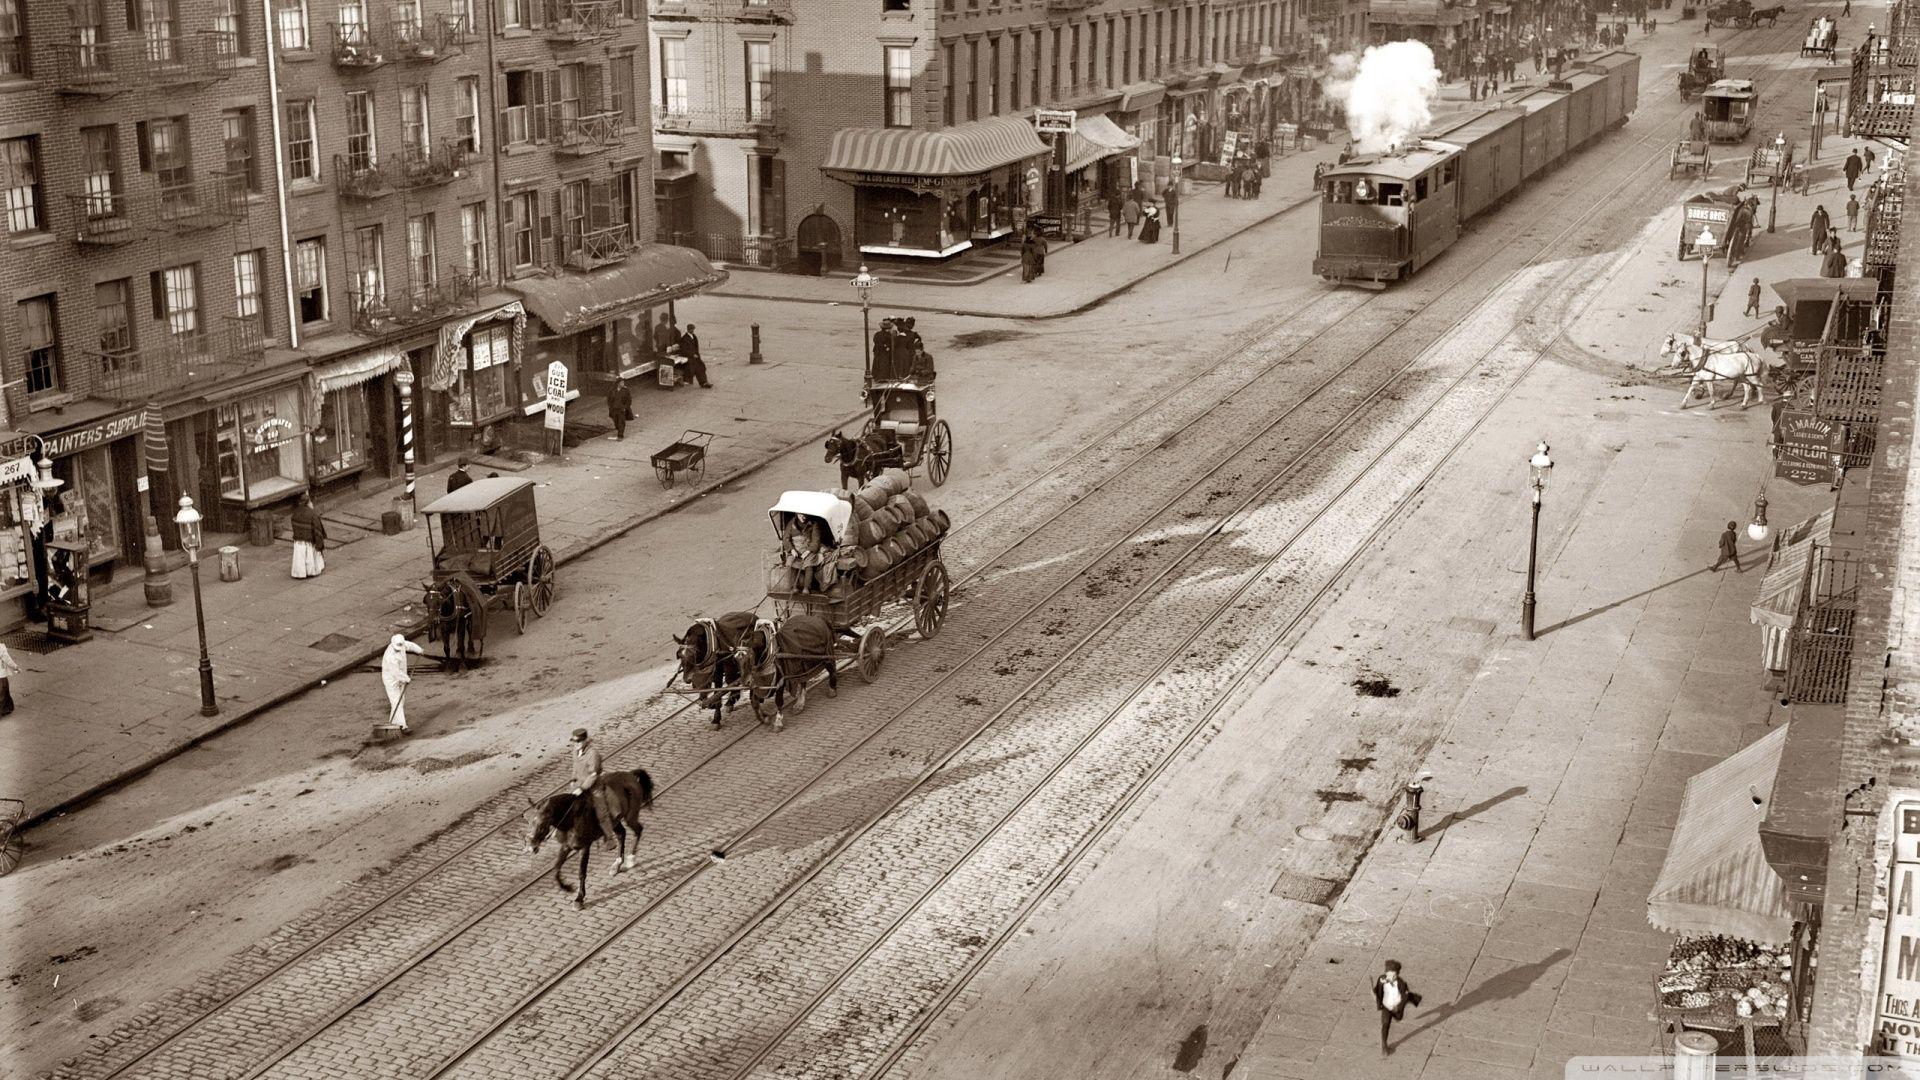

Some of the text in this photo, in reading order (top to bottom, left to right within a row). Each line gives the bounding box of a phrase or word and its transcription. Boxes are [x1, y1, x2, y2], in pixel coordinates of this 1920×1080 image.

[549, 377, 565, 388] ICE
[547, 386, 565, 399] COAL
[546, 402, 565, 415] WOOD
[43, 426, 103, 456] PAINTERS
[1786, 442, 1828, 459] TAILOR
[4, 463, 20, 475] 267
[656, 459, 671, 469] ICE
[1790, 469, 1816, 480] 272
